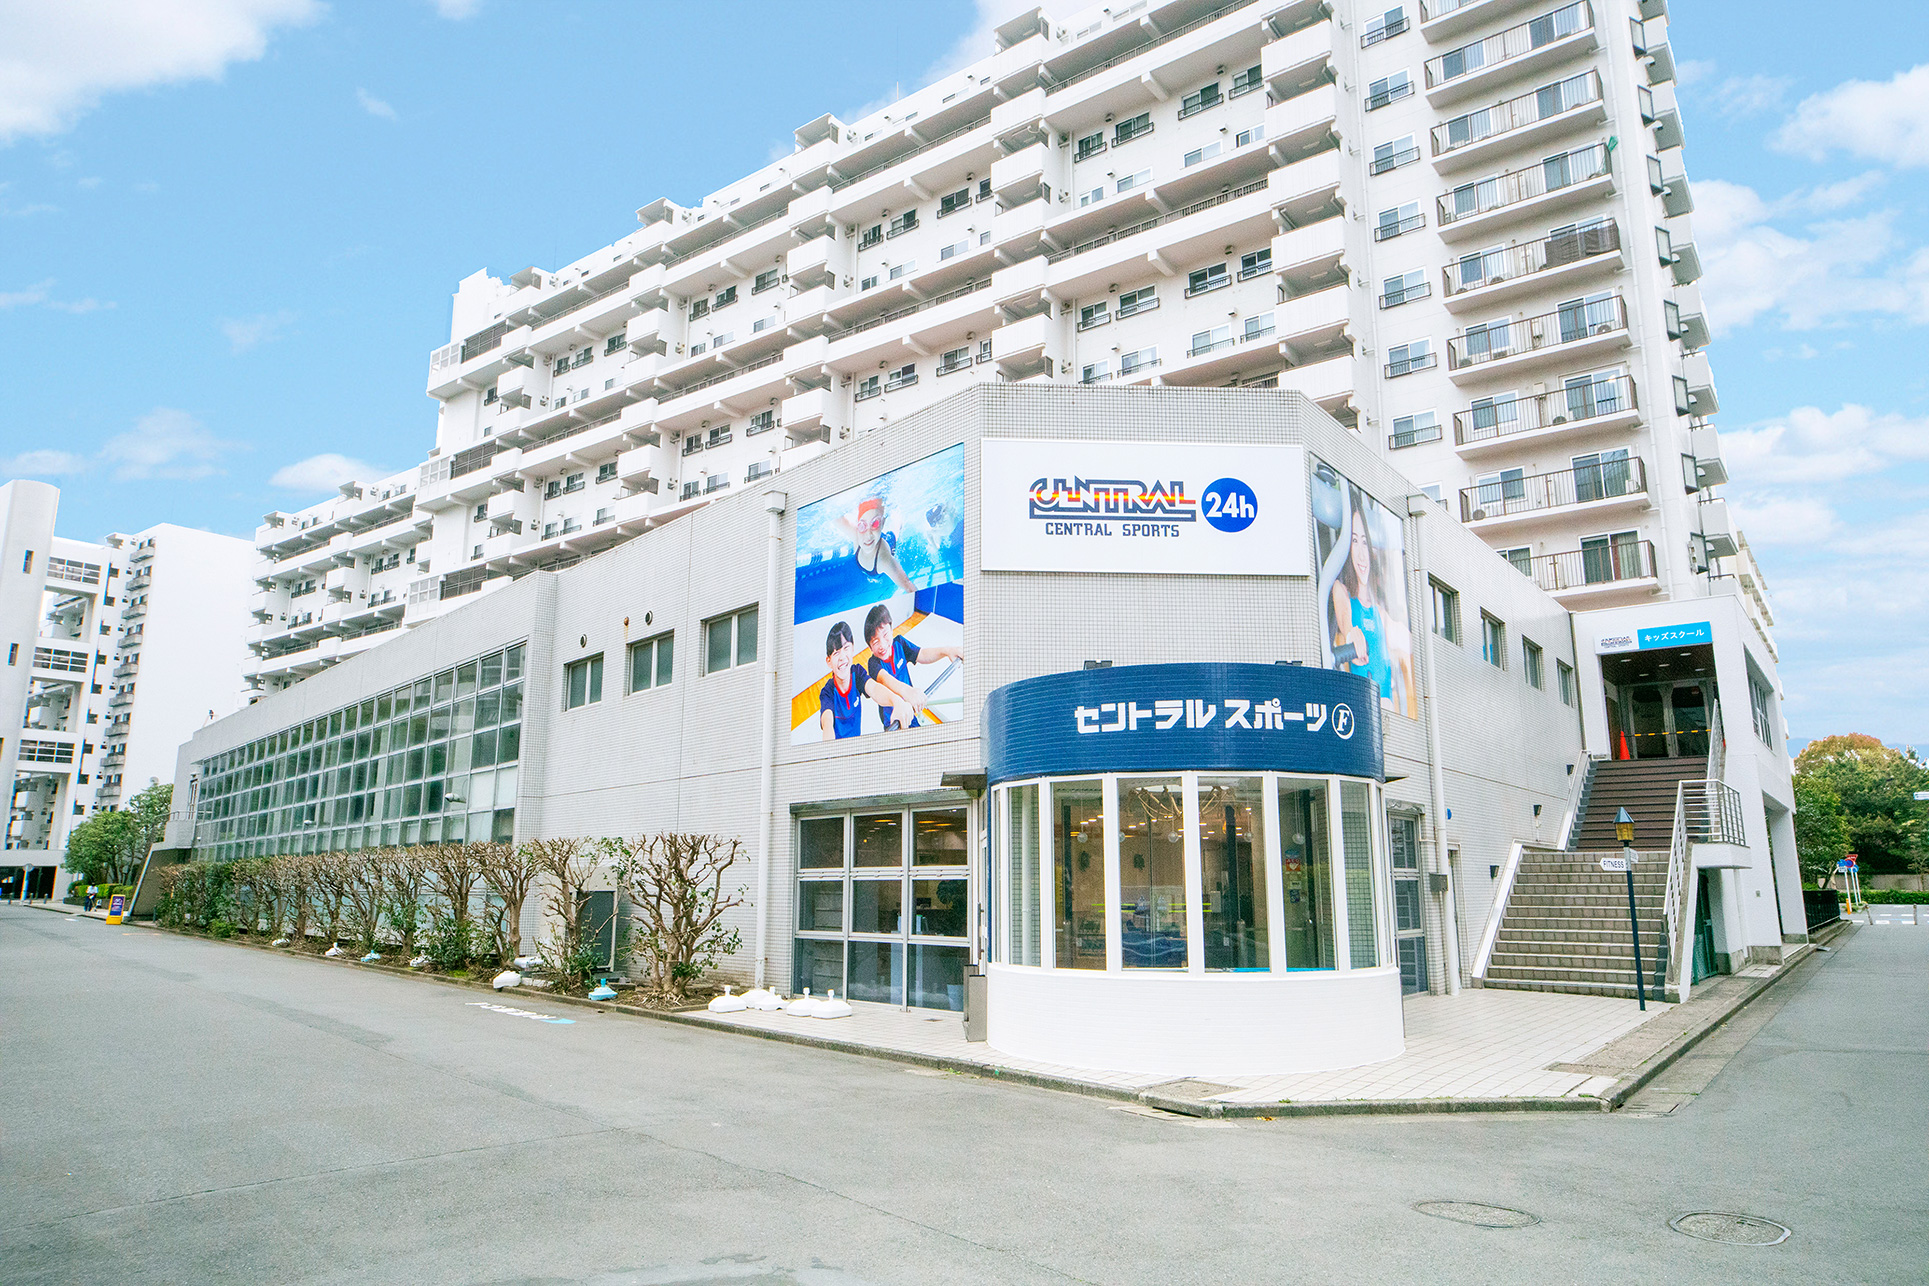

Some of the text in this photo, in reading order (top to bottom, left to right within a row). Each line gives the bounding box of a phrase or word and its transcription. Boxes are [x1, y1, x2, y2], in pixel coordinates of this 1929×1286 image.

[1029, 475, 1254, 521] CENTRAL 24h
[1045, 522, 1180, 538] CENTRAL SPORTS
[1645, 629, 1704, 642] キッズスクール
[1074, 699, 1216, 734] セントラル
[1224, 697, 1327, 732] スポーツ
[1603, 860, 1624, 868] FITNESS
